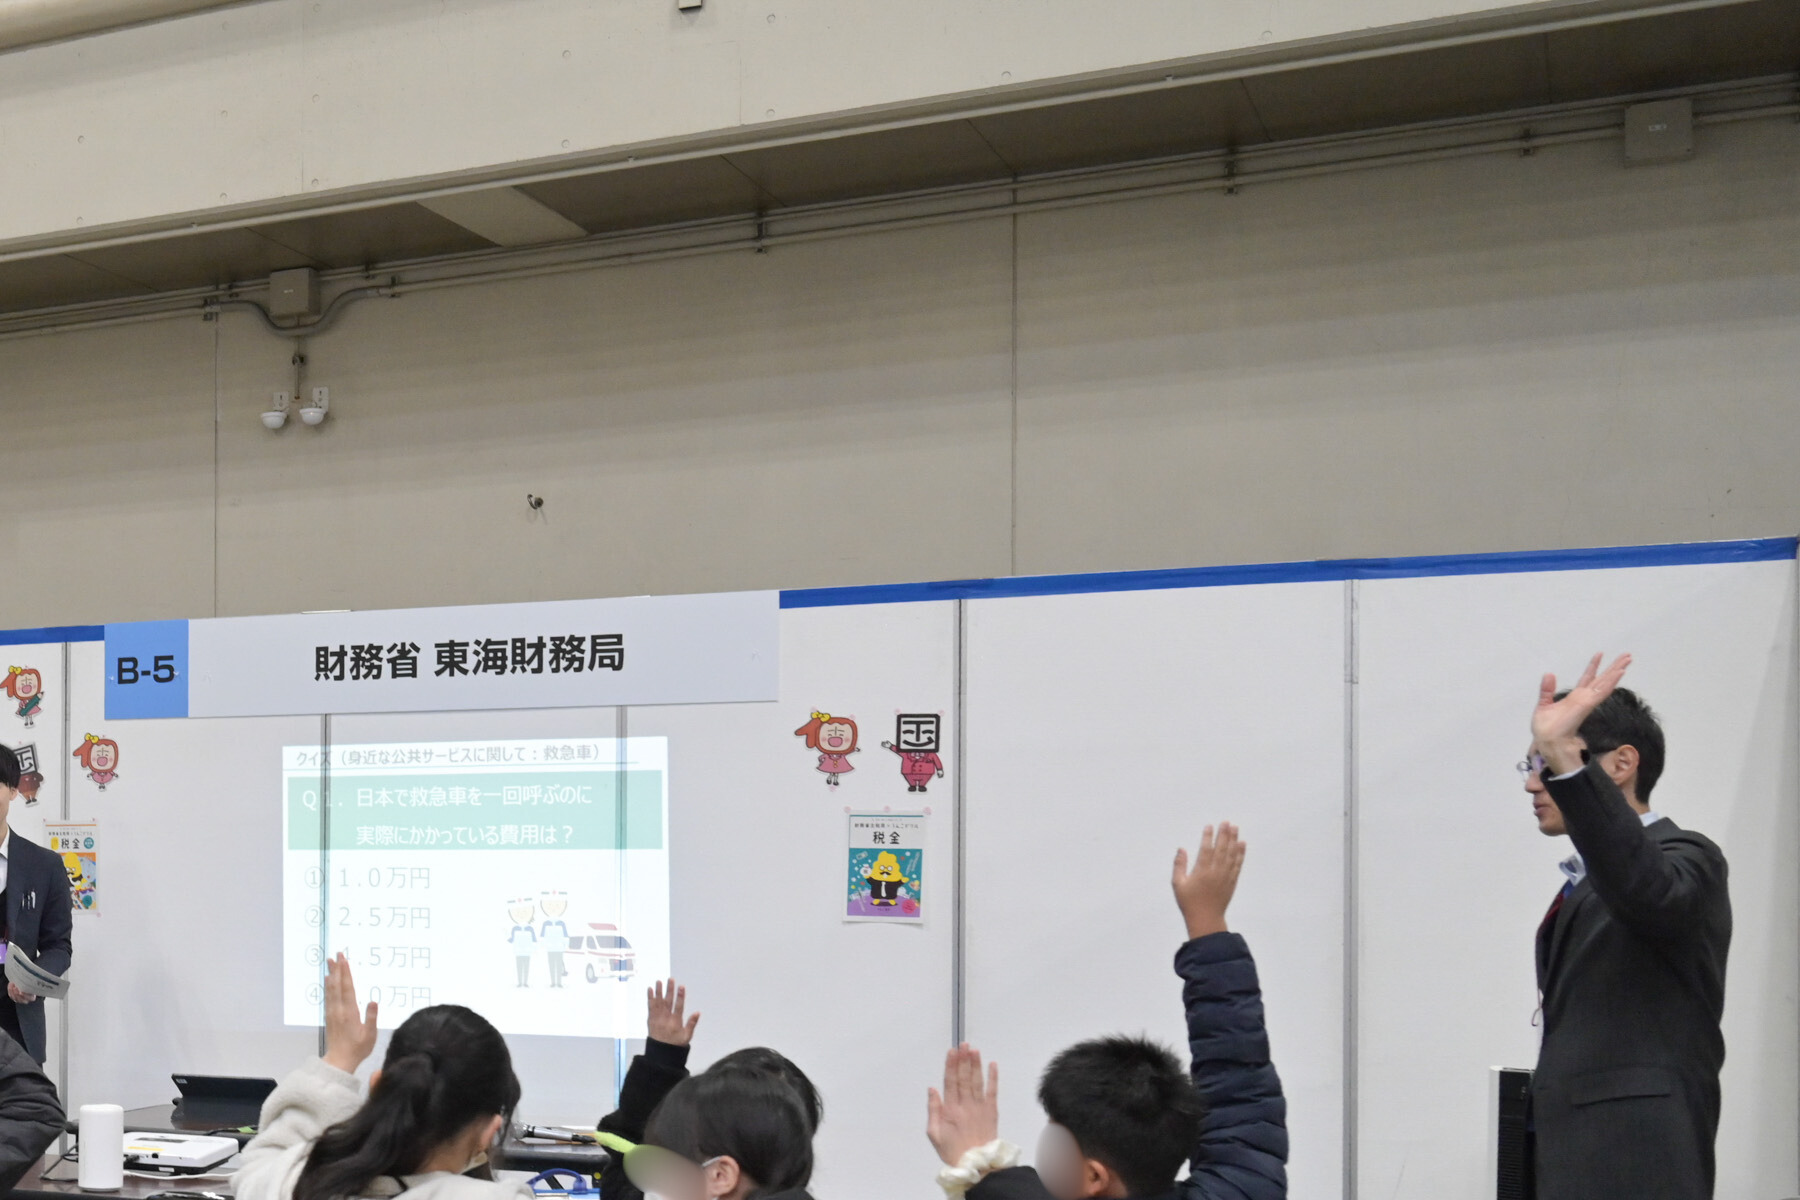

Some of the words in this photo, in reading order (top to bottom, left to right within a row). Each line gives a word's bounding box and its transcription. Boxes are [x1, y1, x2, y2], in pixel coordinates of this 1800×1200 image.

[116, 655, 177, 686] B-5
[314, 641, 420, 682] 財務省
[433, 633, 625, 677] 東海財務局
[356, 784, 593, 808] 日本で救急車を一回呼ぶのに
[356, 824, 574, 846] 実際にかかっている費用は？
